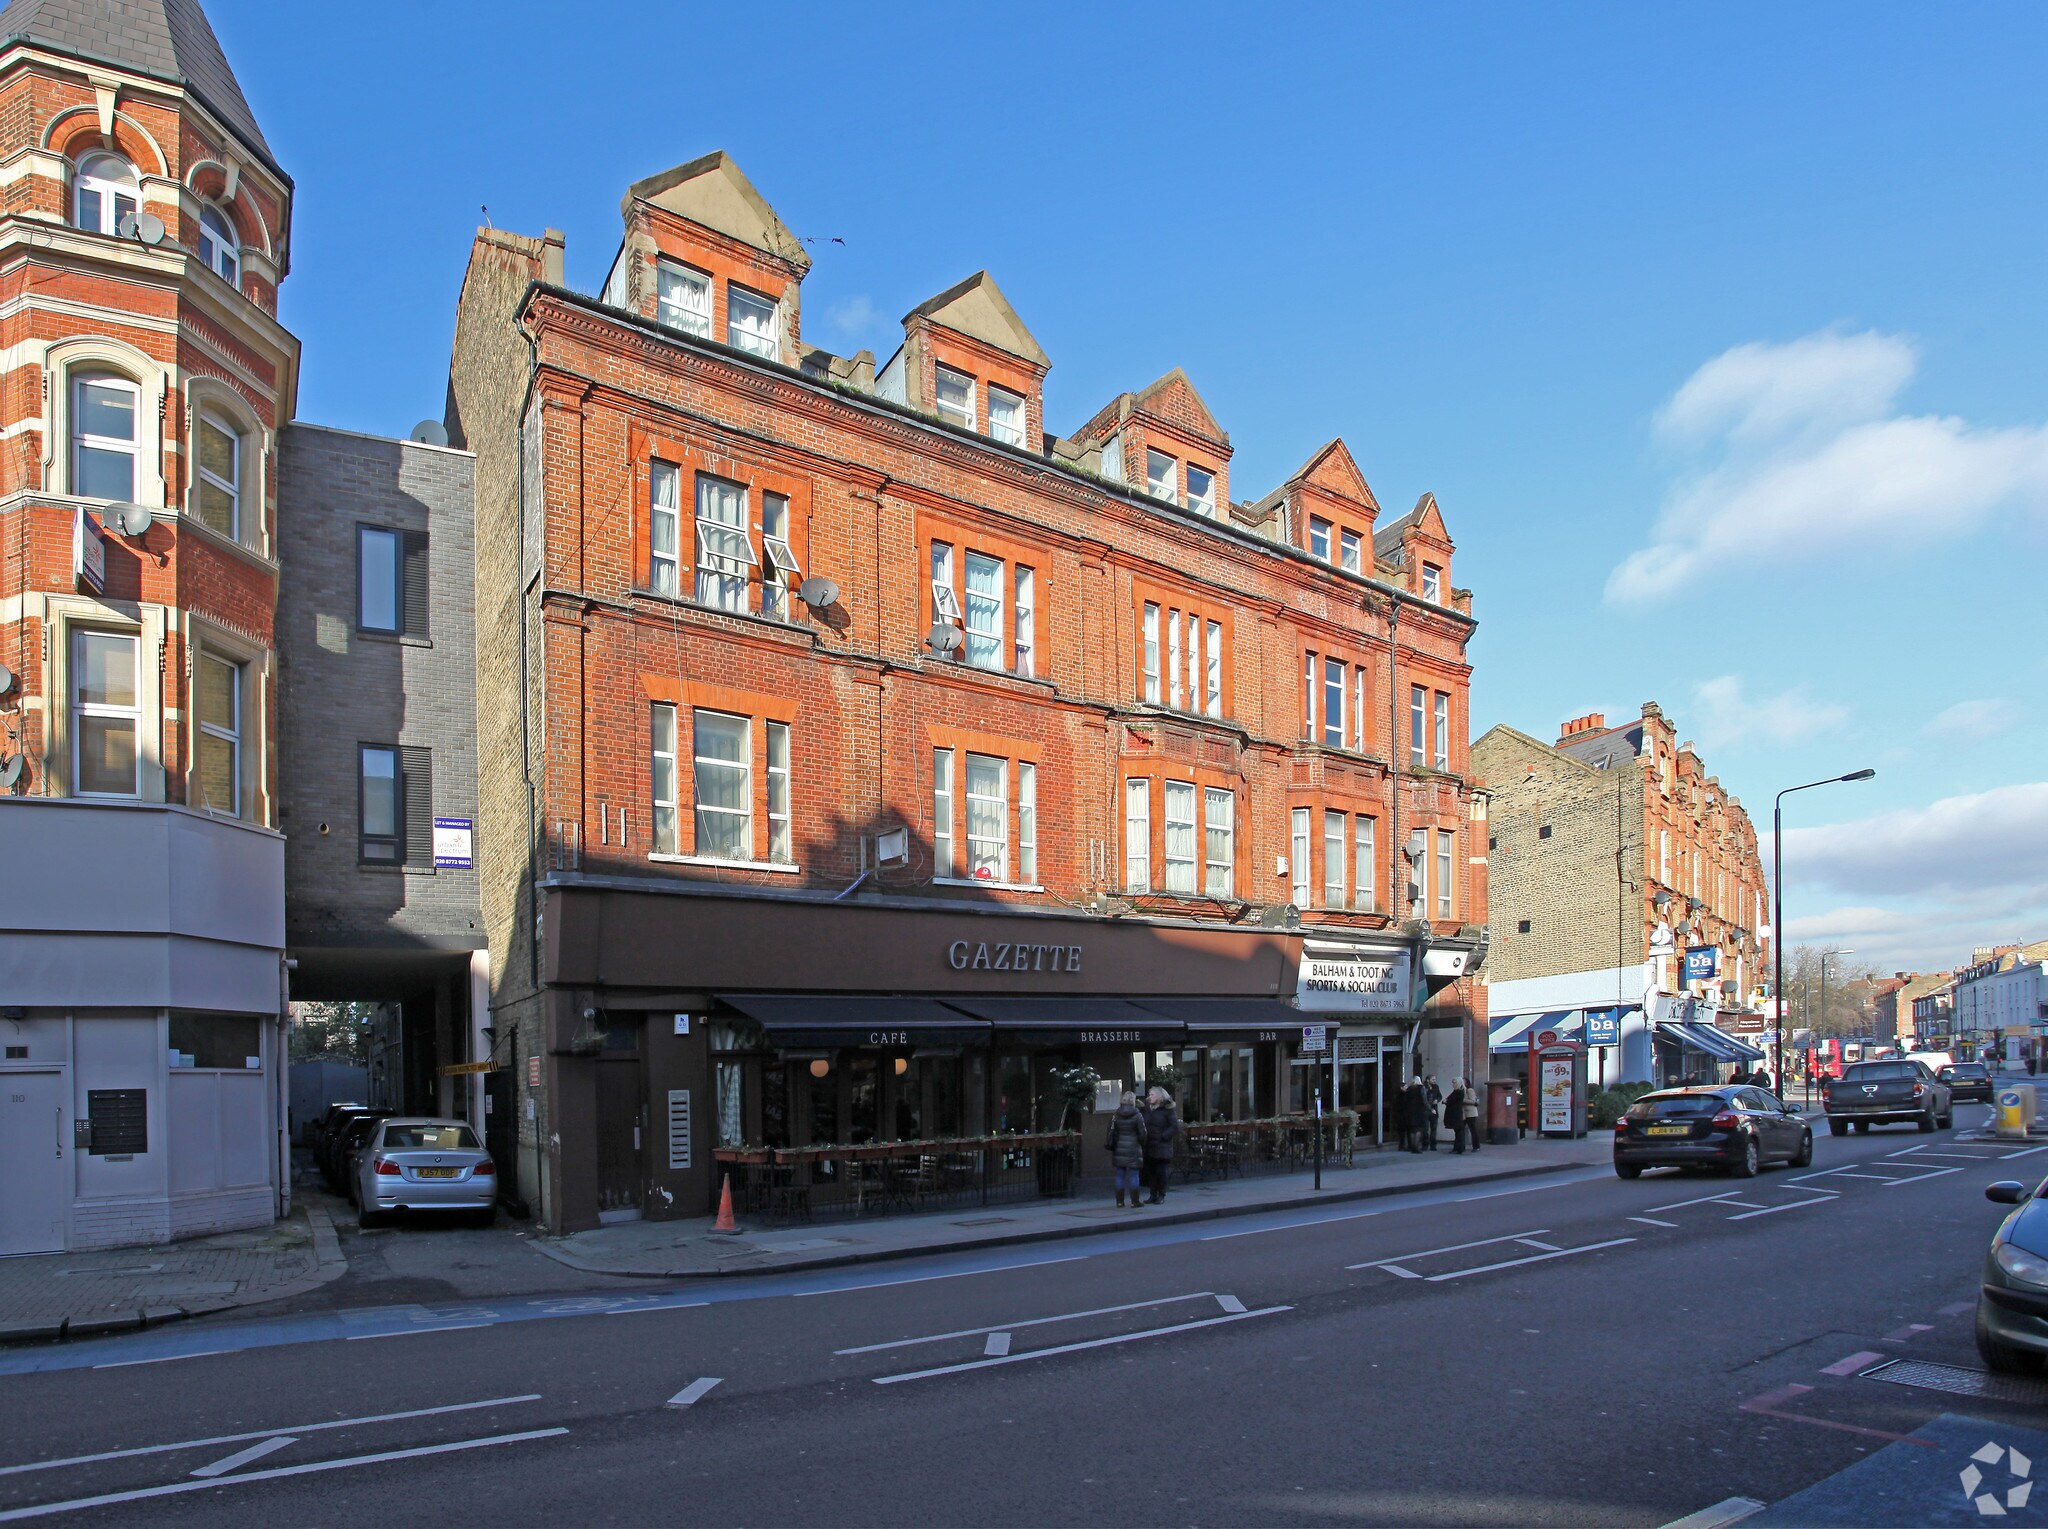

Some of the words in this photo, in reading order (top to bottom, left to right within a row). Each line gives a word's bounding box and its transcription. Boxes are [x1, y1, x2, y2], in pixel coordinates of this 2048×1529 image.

[950, 940, 1082, 972] GAZETTE
[1312, 964, 1347, 977] BALHAM
[1349, 968, 1354, 977] &
[1306, 979, 1338, 992] SPORTS
[1340, 980, 1346, 992] &
[1348, 980, 1375, 993] SOCIAL
[1377, 982, 1397, 994] CLUB
[870, 1031, 907, 1044] CAFÉ
[1081, 1032, 1140, 1042] BRASSERIE
[1260, 1032, 1276, 1040] BAR
[12, 1094, 25, 1103] 110
